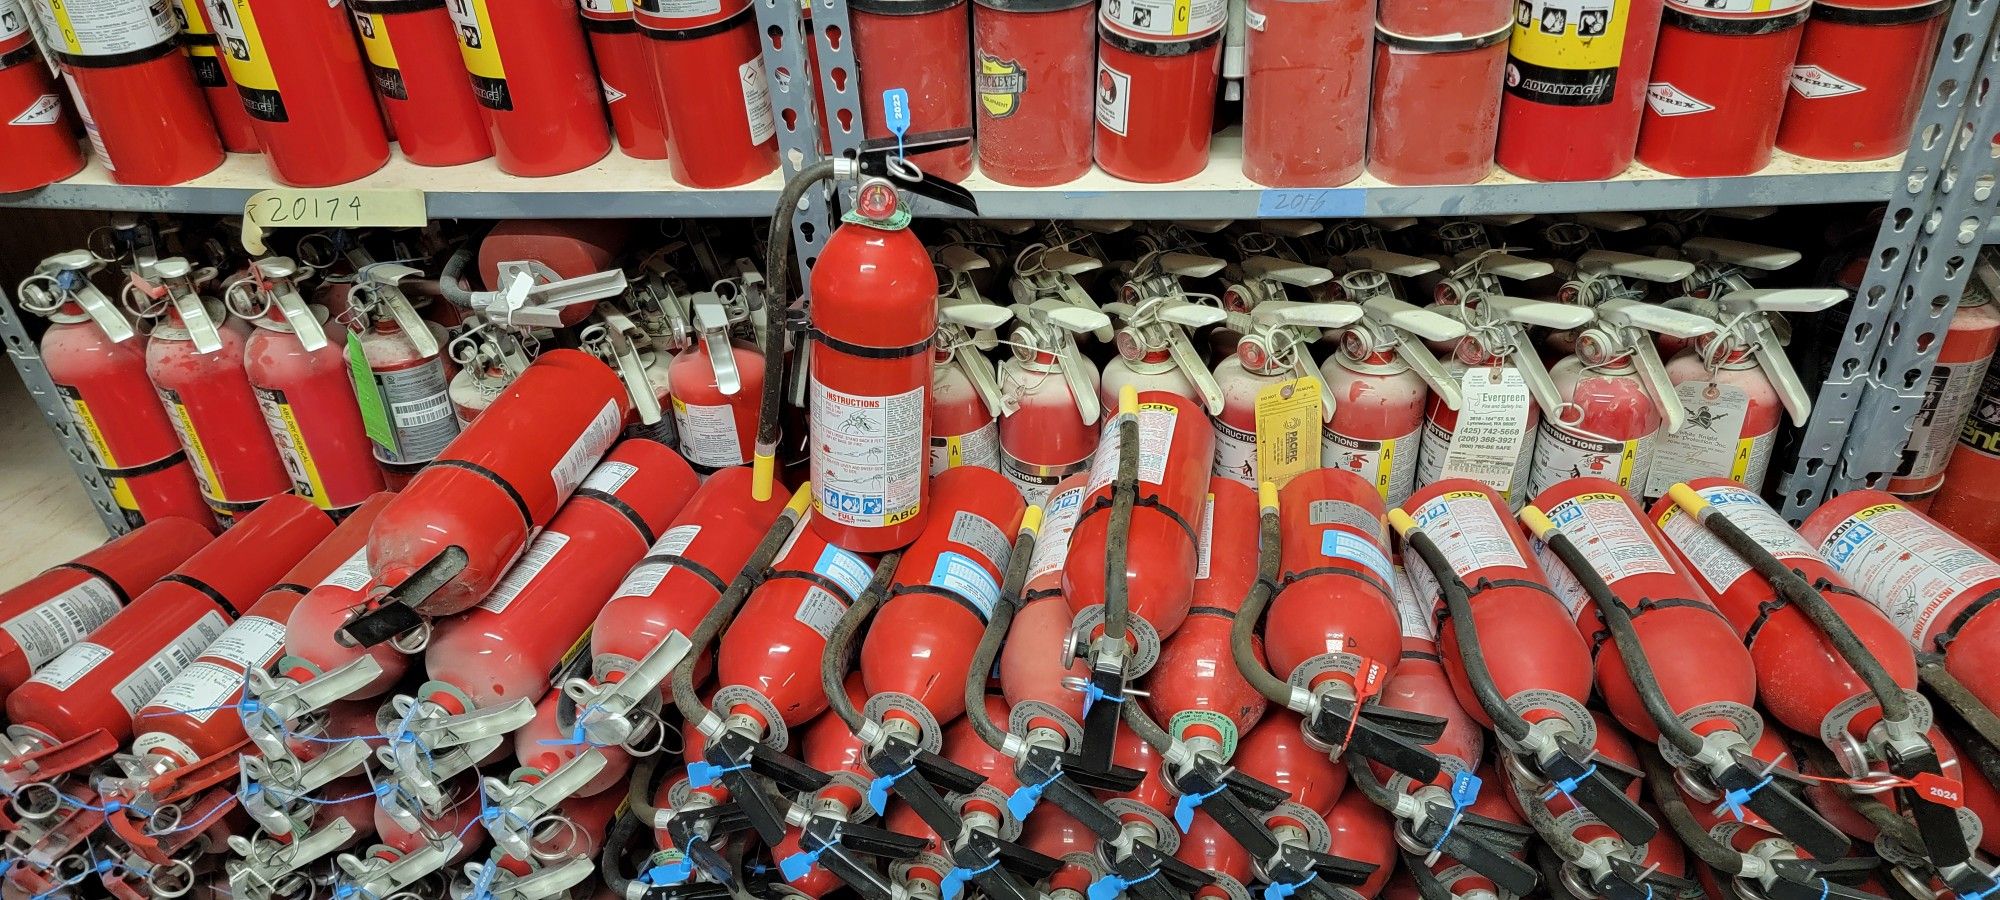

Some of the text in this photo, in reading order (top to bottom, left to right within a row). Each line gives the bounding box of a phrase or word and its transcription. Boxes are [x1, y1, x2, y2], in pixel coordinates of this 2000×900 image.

[1178, 5, 1186, 23] C
[64, 29, 75, 44] C
[1523, 79, 1601, 96] ADVANTAGE
[893, 94, 903, 120] 2023
[1274, 190, 1330, 212] 2016
[826, 391, 880, 408] INSTRUCTIONS
[1483, 393, 1526, 404] Evergreen
[1141, 404, 1175, 412] ABC
[77, 403, 108, 457] ABC DRY CHEMICAL
[178, 406, 206, 461] ABC DRY CHEMICAL
[1213, 420, 1256, 442] NSTRUCTIO
[1460, 427, 1481, 435] (425)
[287, 418, 296, 431] DRY
[293, 431, 309, 463] CHEMICAL
[1289, 430, 1299, 463] PACIFIC
[1322, 430, 1359, 448] UCTIONS
[1458, 435, 1479, 443] (206)
[951, 445, 958, 456] A
[1384, 448, 1390, 460] A
[1625, 450, 1633, 460] A
[1739, 448, 1747, 459] A
[1380, 474, 1387, 485] B
[1620, 477, 1628, 487] B
[1450, 491, 1484, 499] ABC
[1582, 494, 1616, 502] ABC
[837, 512, 855, 521] FULL
[889, 506, 917, 523] ABC
[1546, 500, 1574, 519] KIDD
[1861, 504, 1897, 517] ABC
[1826, 518, 1856, 549] KIDDE
[1912, 587, 1955, 641] INSTRUCTIONS
[1367, 664, 1380, 685] 2024
[1458, 776, 1470, 794] 2023
[1930, 786, 1958, 800] 2024
